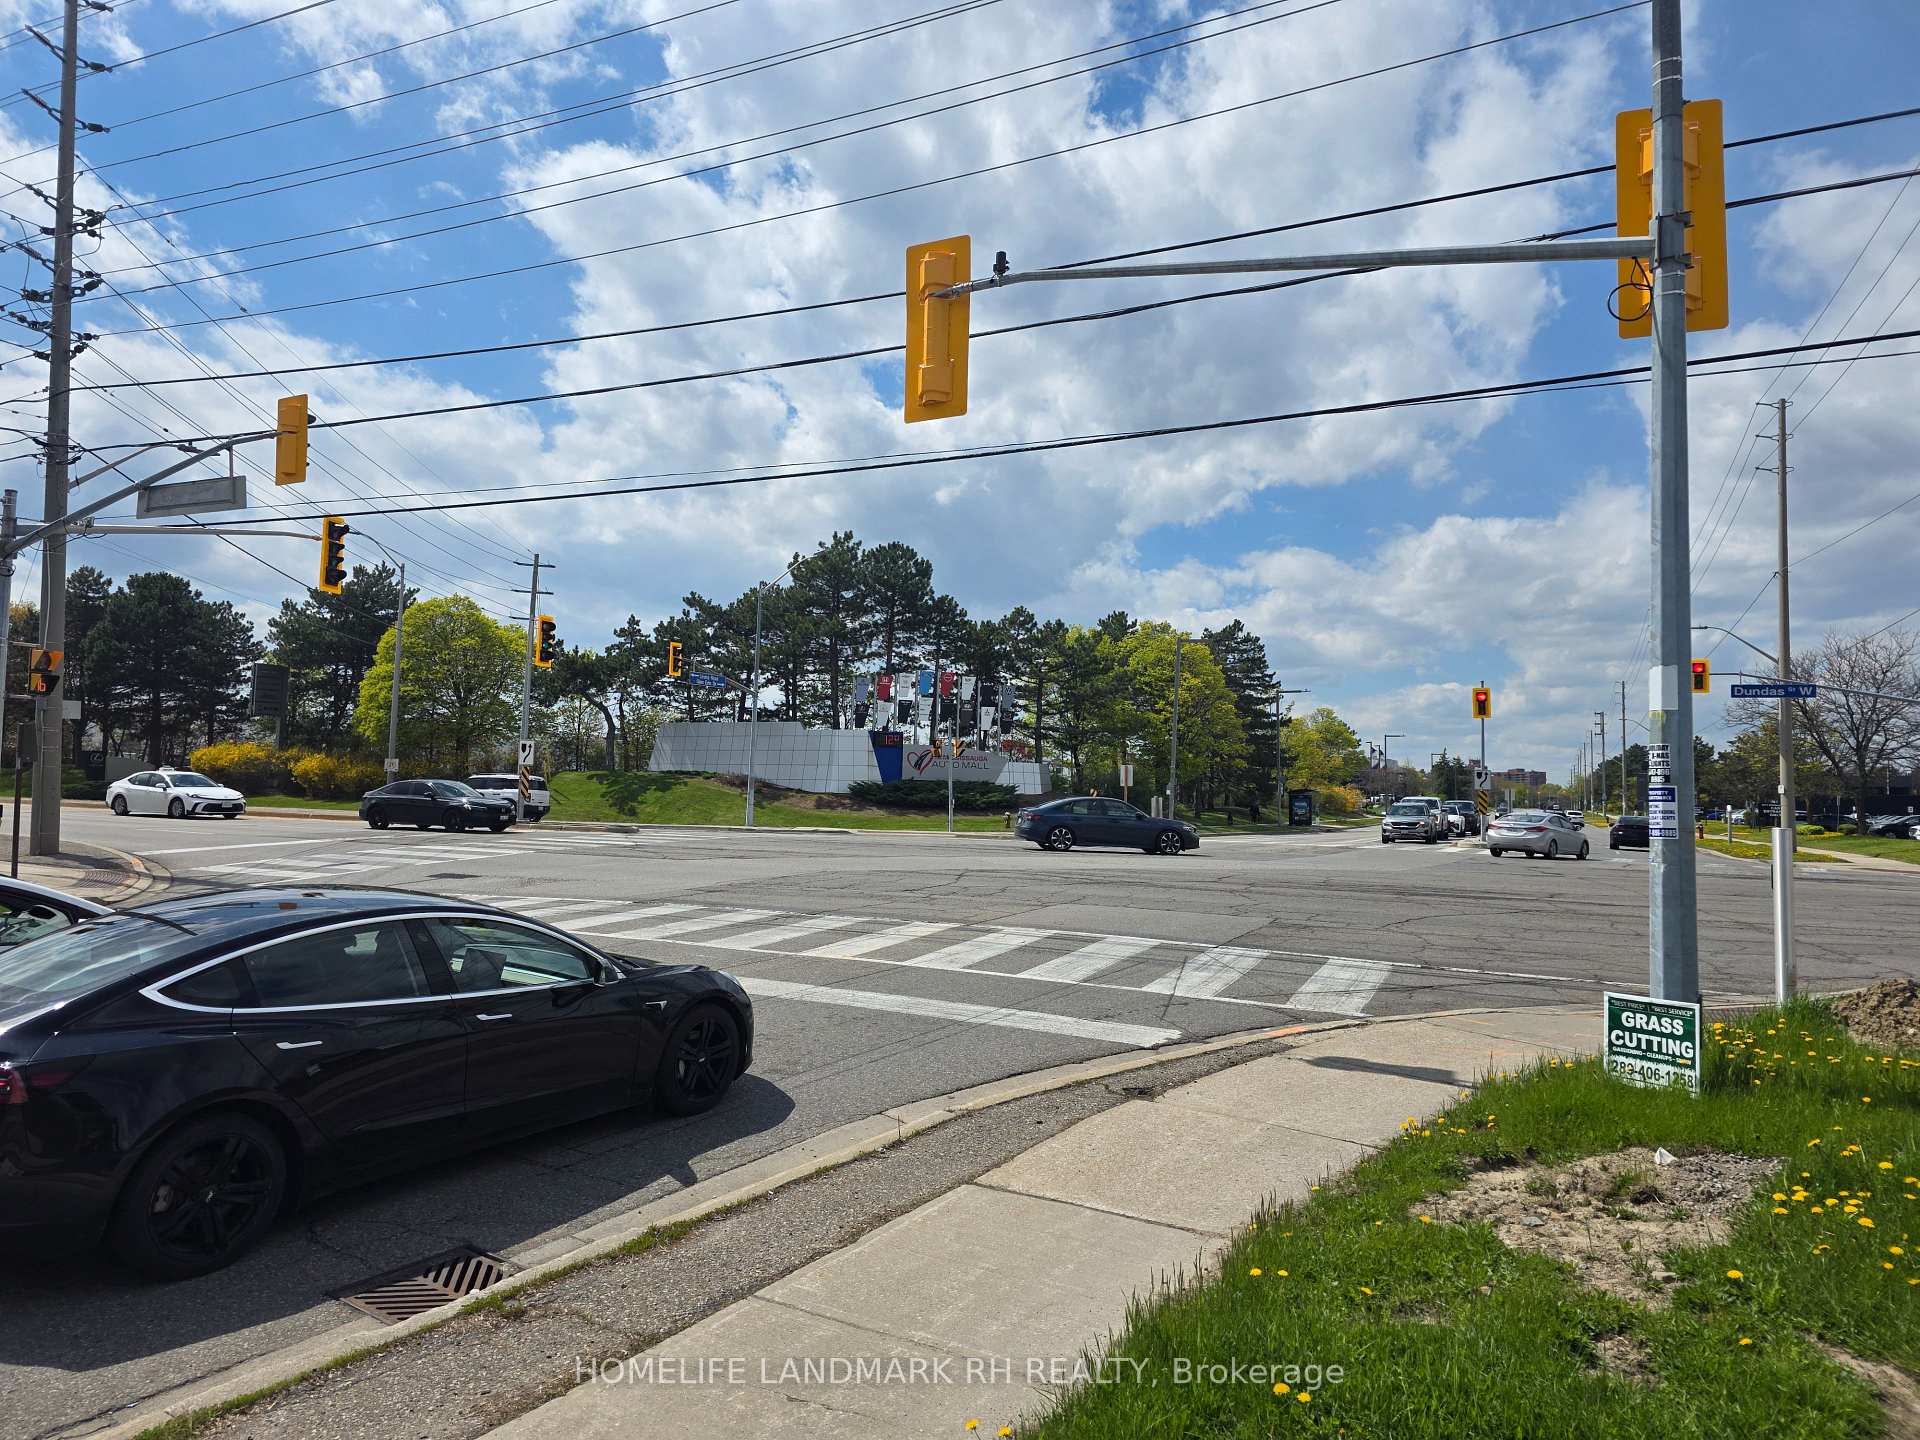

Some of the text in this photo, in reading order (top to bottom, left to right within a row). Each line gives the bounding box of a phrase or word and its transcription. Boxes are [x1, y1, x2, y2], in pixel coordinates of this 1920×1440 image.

[1734, 686, 1785, 696] Dundas
[1799, 686, 1813, 695] W
[932, 761, 989, 770] AUO MALL
[1621, 1011, 1684, 1036] GRASS
[1610, 1029, 1694, 1058] CUTTING
